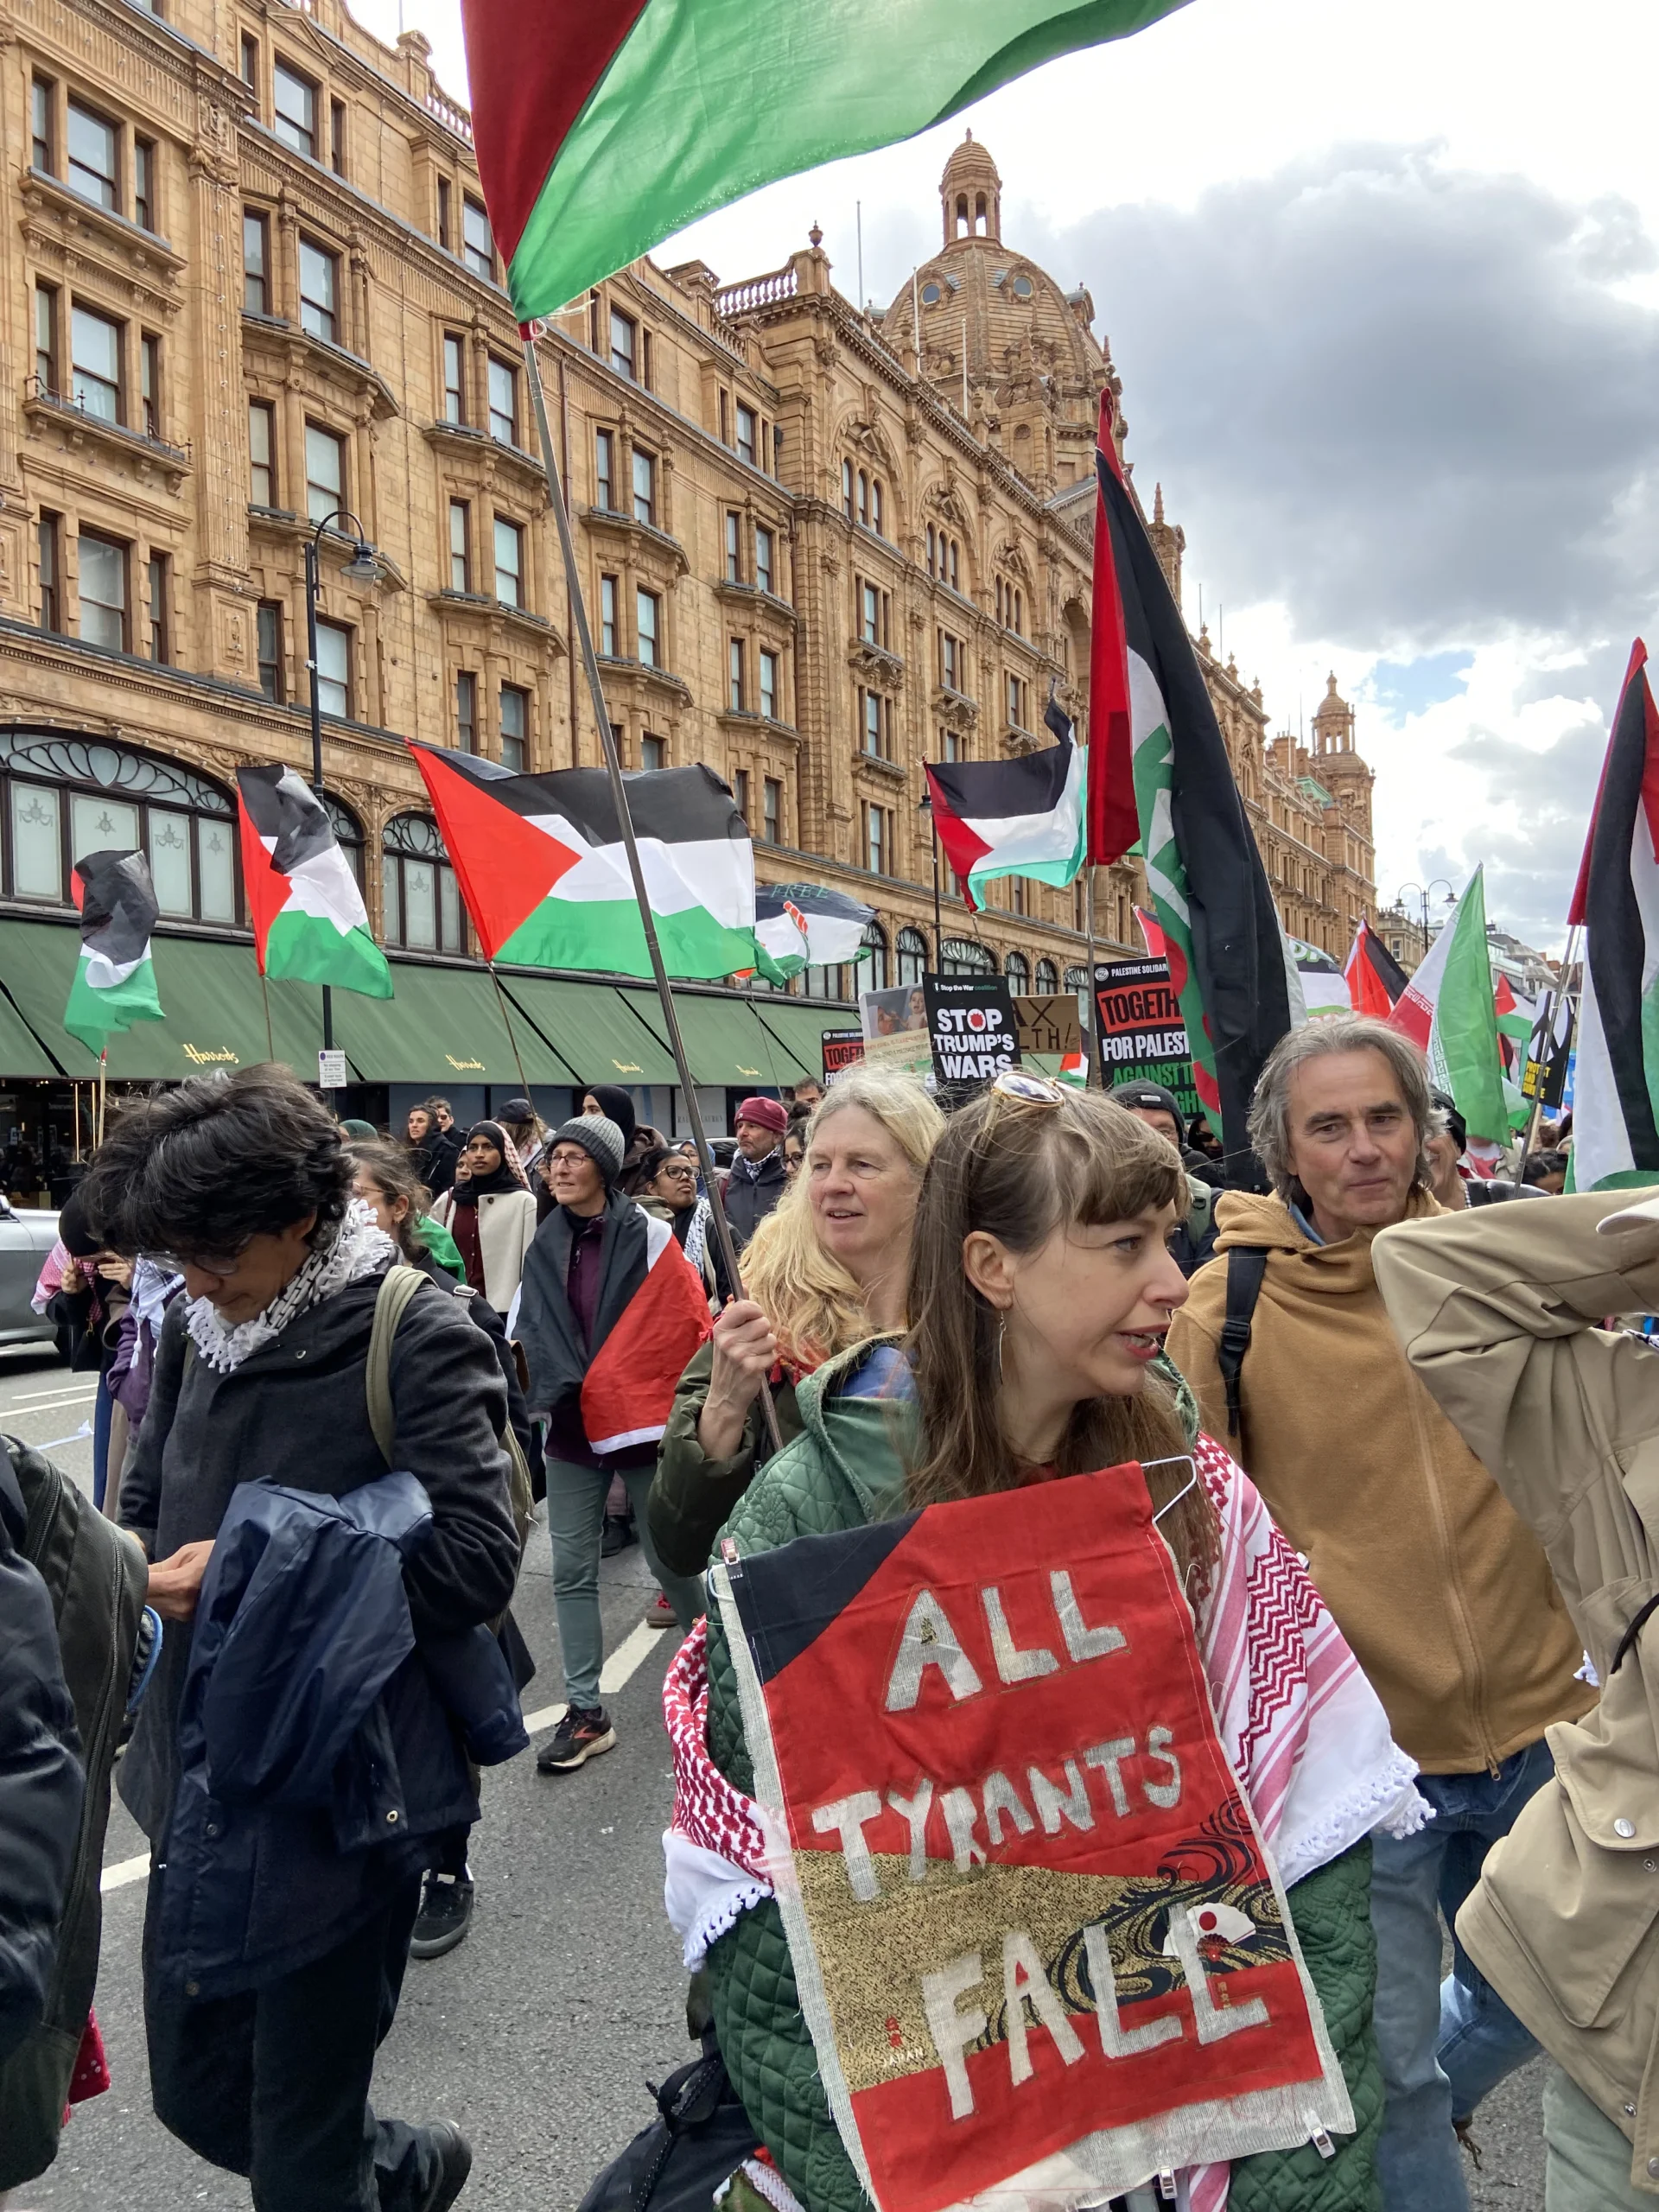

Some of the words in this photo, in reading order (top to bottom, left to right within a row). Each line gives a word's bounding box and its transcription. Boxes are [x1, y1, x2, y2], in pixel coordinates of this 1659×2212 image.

[771, 884, 830, 899] FREE
[1111, 965, 1141, 977] PALESTINE
[1141, 963, 1166, 974] SOLIDAR
[1101, 988, 1182, 1026] TOGETH
[937, 1008, 1002, 1033] STOP
[933, 1033, 1015, 1052] TRUMP'S
[1016, 1023, 1071, 1050] LTH!
[1102, 1036, 1135, 1062] FOR
[1135, 1031, 1190, 1058] PALEST
[183, 1044, 239, 1065] Harrods
[445, 1054, 486, 1071] Harrods
[940, 1054, 1013, 1078] WARS
[885, 1570, 1127, 1712] ALL
[811, 1726, 1181, 1901] TYRANTS
[922, 1903, 1269, 2120] FALL
[882, 2045, 925, 2068] JAPAN
